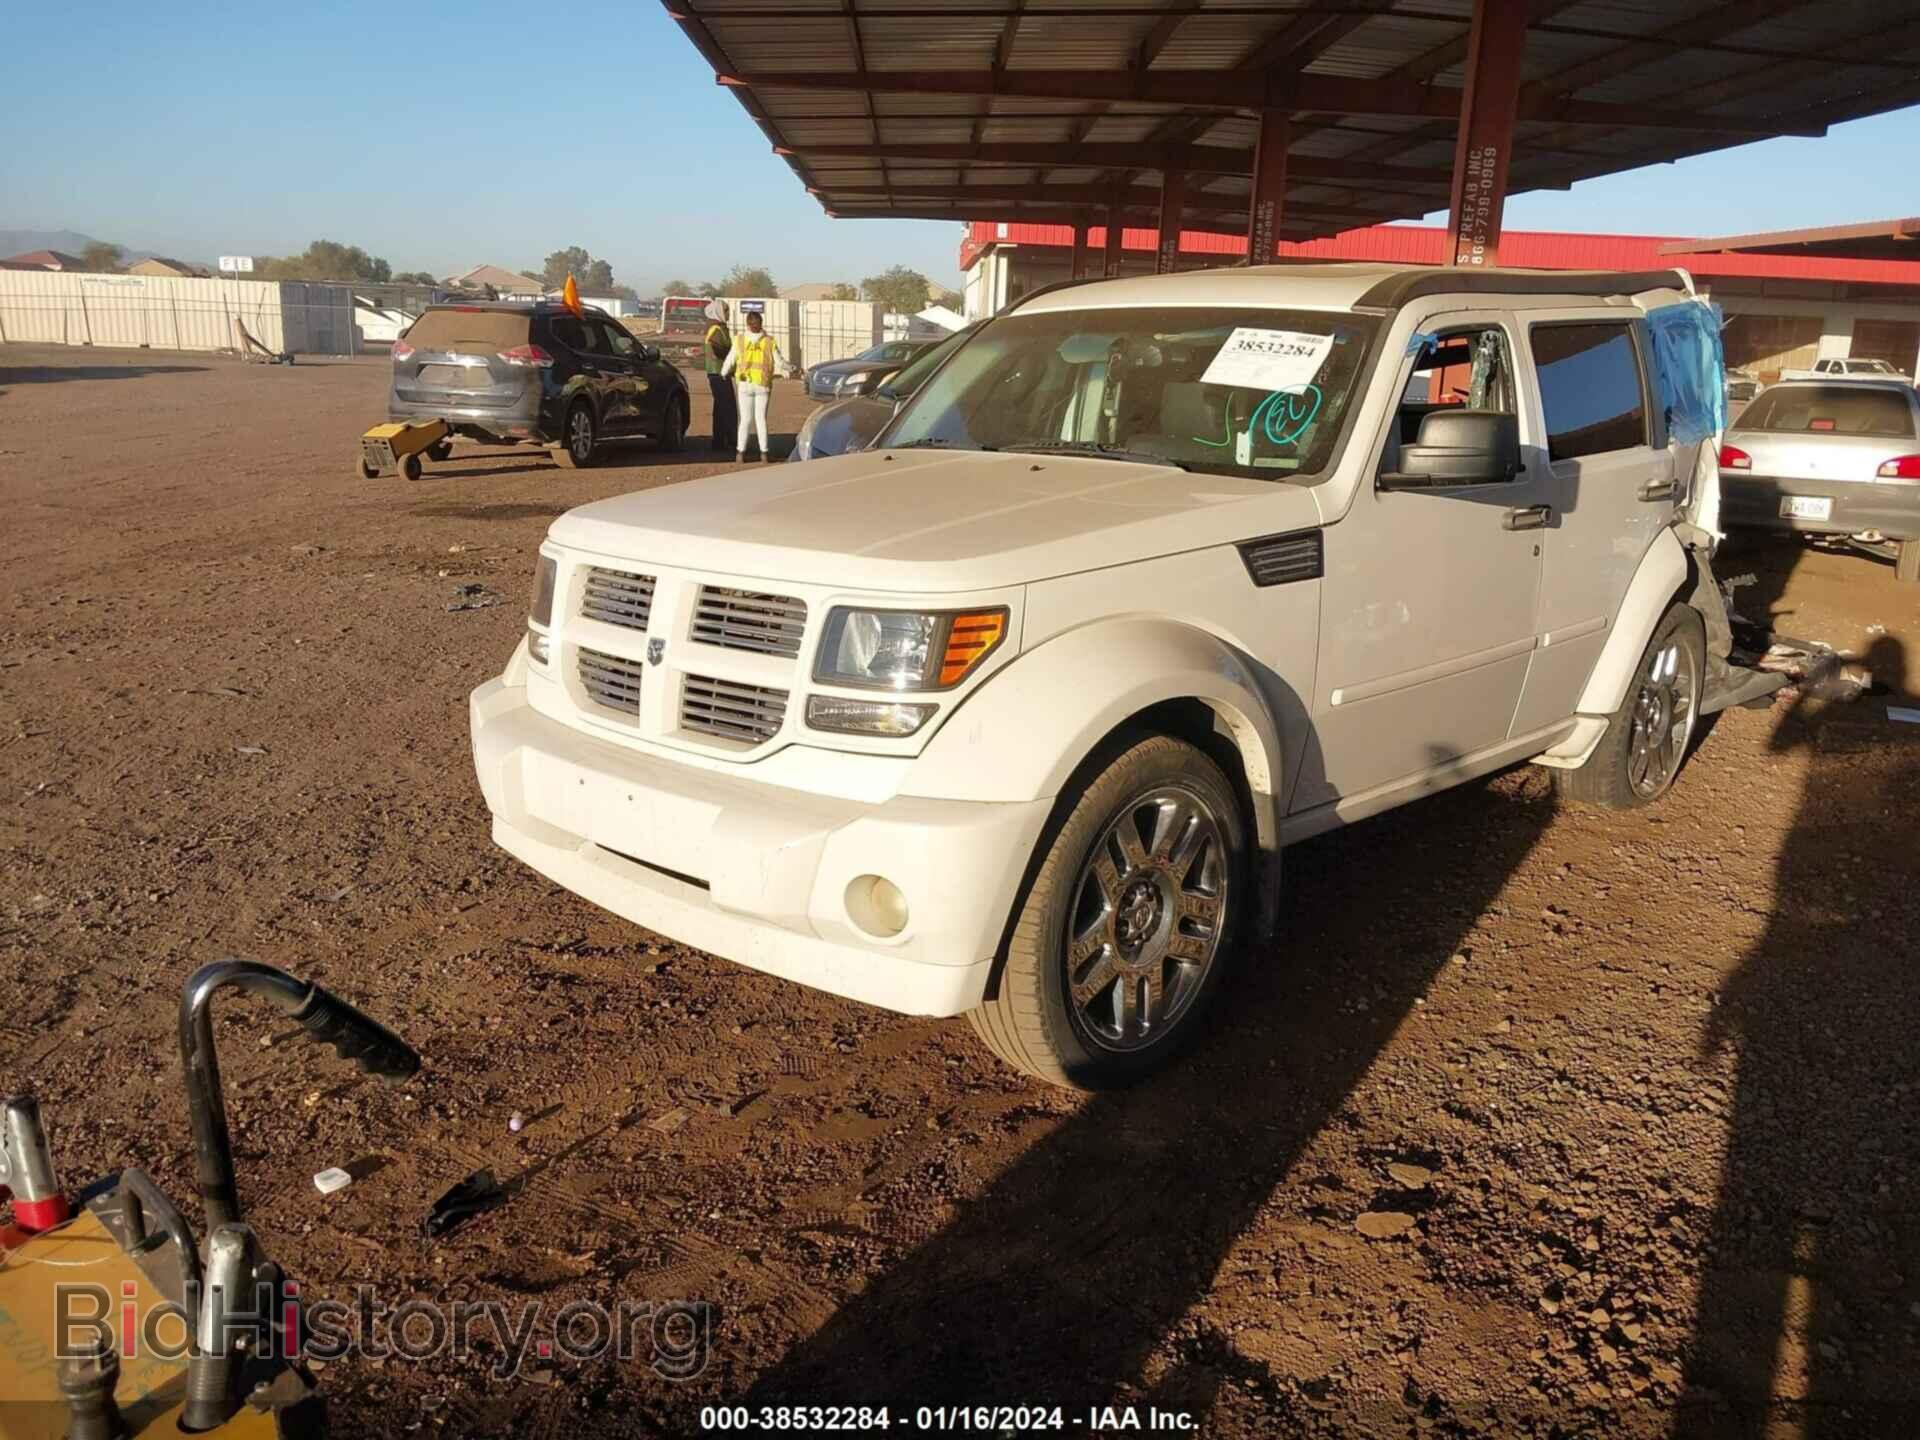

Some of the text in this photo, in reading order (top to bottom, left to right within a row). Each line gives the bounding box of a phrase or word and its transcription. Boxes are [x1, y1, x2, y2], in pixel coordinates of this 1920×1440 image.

[1467, 146, 1484, 175] INC.
[1459, 183, 1478, 242] PREFAB
[1232, 340, 1316, 357] 38532284
